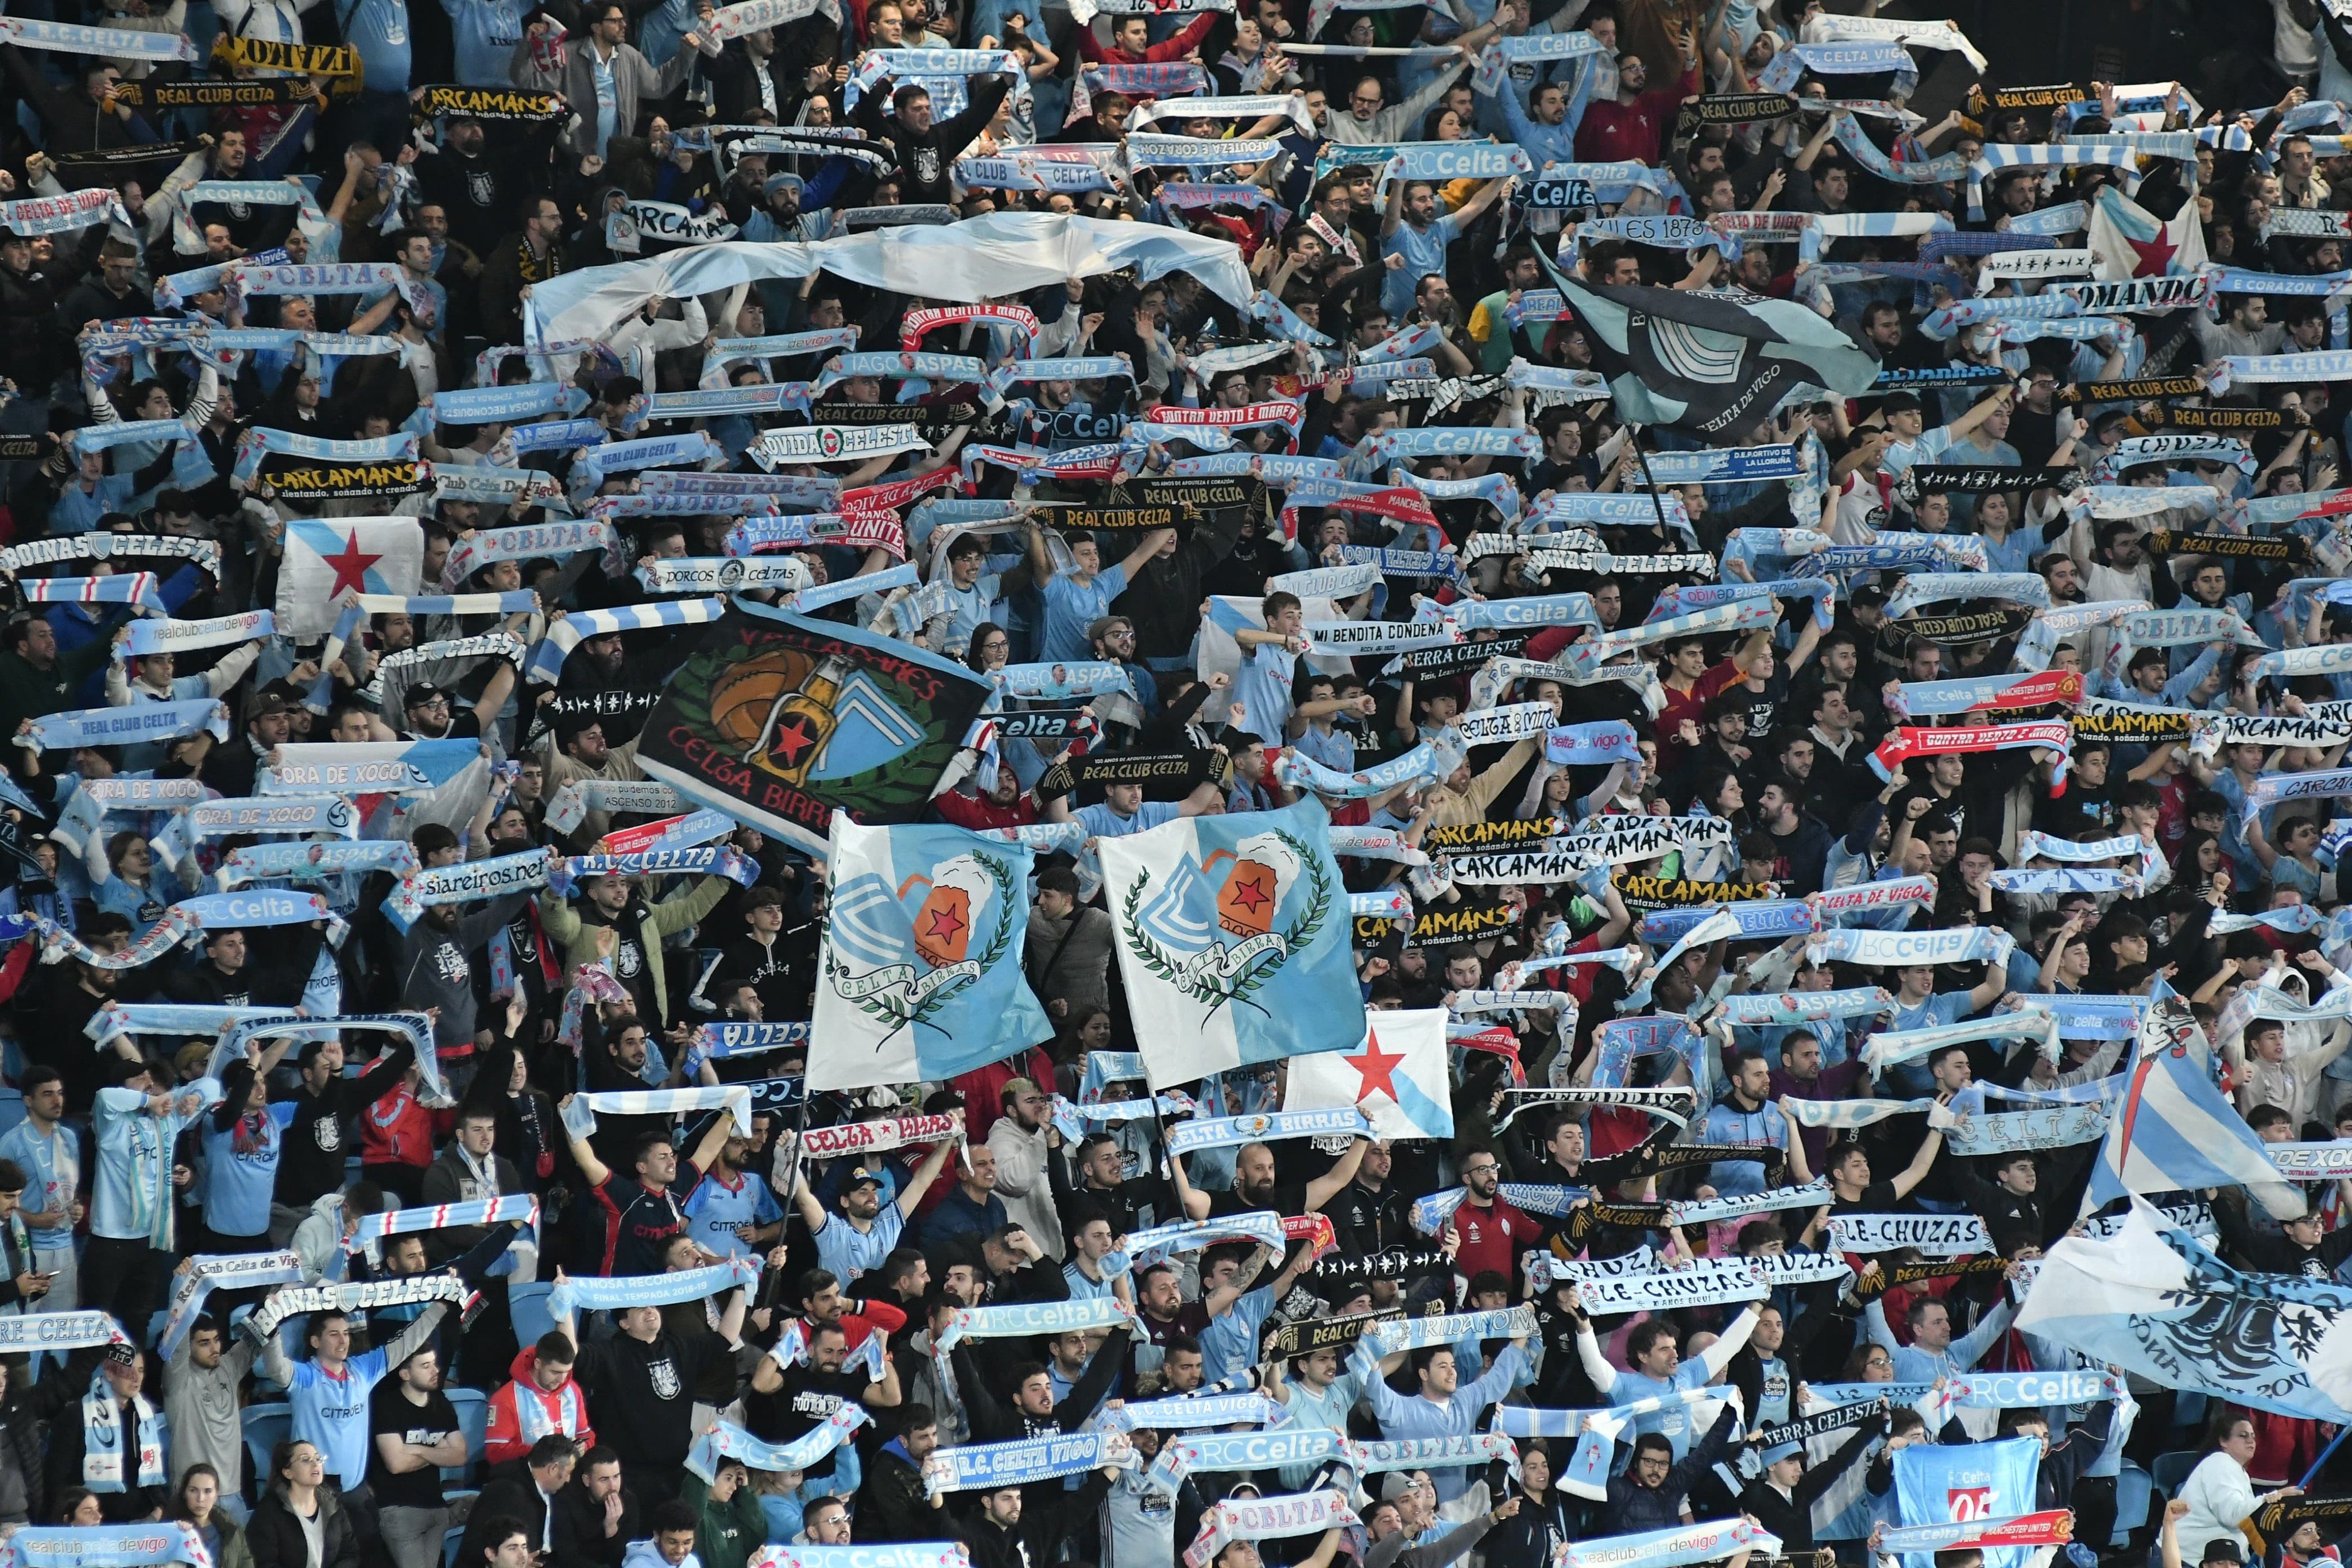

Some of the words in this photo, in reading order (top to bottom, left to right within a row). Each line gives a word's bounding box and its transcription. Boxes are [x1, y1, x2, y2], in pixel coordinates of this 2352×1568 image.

[1824, 49, 1869, 63] CELTA
[156, 88, 195, 103] REAL
[196, 89, 231, 103] CLUB
[235, 87, 275, 102] CELTA
[1995, 93, 2025, 107] REAL
[2027, 92, 2053, 106] CLUB
[2056, 88, 2085, 103] CELTA
[1700, 103, 1727, 118] REAL
[1729, 103, 1756, 117] CLUB
[1759, 99, 1790, 115] CELTA
[1211, 140, 1270, 152] AFOUTEZA
[977, 161, 1007, 181] CLUB
[1053, 167, 1092, 184] CELTA
[204, 184, 288, 202] CORAZÓN
[15, 201, 55, 220] CELTA
[57, 198, 76, 215] DE
[1664, 217, 1704, 238] 1873
[1754, 215, 1770, 230] DE
[276, 265, 374, 287] CELTA
[2246, 279, 2316, 293] CORAZÓN
[944, 306, 981, 317] VENTO
[1526, 294, 1565, 312] REAL
[853, 355, 899, 372] IAGO
[916, 356, 979, 373] ASPAS
[1355, 361, 1404, 380] CELTA
[514, 388, 540, 396] FINAL
[1740, 393, 1754, 411] DE
[1751, 364, 1781, 394] VIGO
[2091, 385, 2130, 400] REAL
[2132, 382, 2163, 397] CLUB
[442, 403, 513, 418] RECONQUISTA
[513, 401, 536, 411] NOSA
[814, 408, 848, 421] REAL
[850, 408, 887, 421] CLUB
[889, 407, 927, 420] CELTA
[1160, 409, 1205, 424] CONTRA
[1208, 406, 1245, 424] VENTO
[1259, 405, 1295, 420] MAREA
[2174, 409, 2207, 425] REAL
[2210, 411, 2242, 426] CLUB
[2244, 412, 2281, 426] CELTA
[2, 442, 38, 455] CELTA
[331, 438, 389, 455] CELTA
[601, 451, 626, 465] REAL
[627, 448, 650, 462] CLUB
[652, 442, 676, 459] CELTA
[1206, 458, 1249, 473] IAGO
[1263, 462, 1316, 478] ASPAS
[1649, 456, 1681, 472] Celta
[1689, 455, 1699, 469] B
[333, 486, 373, 497] soñando
[1210, 486, 1245, 502] CELTA
[1295, 481, 1336, 497] Celta
[1067, 509, 1098, 526] REAL
[1103, 509, 1136, 526] CLUB
[1138, 508, 1171, 525] CELTA
[501, 525, 582, 552] CELTA
[2181, 539, 2206, 555] REAL
[2212, 539, 2247, 556] CLUB
[2250, 541, 2288, 557] CELTA
[4, 537, 88, 571] BOINAS
[1612, 553, 1714, 576] CELESTE
[1948, 615, 1979, 632] CLUB
[1978, 611, 2007, 628] REAL
[2084, 610, 2102, 625] DE
[2133, 614, 2212, 640] CELTA
[1314, 629, 1328, 643] MI
[1333, 626, 1382, 640] BENDITA
[1388, 622, 1444, 640] CONDENA
[1457, 638, 1523, 663] CELESTE
[82, 719, 110, 735] REAL
[112, 716, 141, 733] CLUB
[144, 711, 177, 728] CELTA
[1460, 715, 1510, 739] CELTA
[1552, 734, 1575, 749] celta
[1576, 736, 1589, 748] de
[1592, 733, 1620, 750] vigo
[1976, 729, 2015, 743] VENTO
[2114, 733, 2149, 742] soñando
[327, 766, 349, 782] DE
[353, 762, 405, 781] XOGO
[1083, 765, 1116, 779] REAL
[1117, 762, 1150, 777] CLUB
[1152, 761, 1189, 776] CELTA
[1373, 752, 1430, 784] ASPAS
[131, 781, 152, 799] DE
[156, 780, 200, 798] XOGO
[605, 797, 652, 808] ASCENSO
[237, 807, 260, 824] DE
[265, 804, 316, 823] XOGO
[1022, 824, 1080, 842] ASPAS
[1475, 841, 1511, 851] soñando
[262, 850, 308, 867] IAGO
[318, 846, 384, 864] ASPAS
[649, 847, 717, 870] CELTA
[425, 857, 546, 896] siareiros.net
[1867, 891, 1885, 904] DE
[1890, 883, 1924, 901] VIGO
[1422, 934, 1464, 946] soñando
[115, 947, 136, 961] DE
[1179, 942, 1220, 992] CELTA
[1231, 934, 1283, 967] BIRRAS
[842, 965, 908, 996] CELTA
[922, 960, 976, 995] BIRRAS
[1472, 989, 1553, 1005] CELTA
[1737, 994, 1782, 1014] IAGO
[1798, 991, 1866, 1011] ASPAS
[1101, 1053, 1124, 1075] RC
[1281, 1112, 1356, 1130] BIRRAS
[2284, 1147, 2307, 1166] DE
[1846, 1218, 1979, 1244] LE-CHUZAS
[176, 1269, 201, 1304] Real
[226, 1259, 258, 1272] Celta
[260, 1256, 274, 1269] de
[579, 1279, 587, 1288] A
[590, 1276, 625, 1290] NOSA
[628, 1264, 721, 1288] RECONQUISTA
[1599, 1271, 1756, 1302] LE-CHUZAS
[593, 1292, 629, 1304] FINAL
[632, 1288, 672, 1301] TEMPADA
[674, 1281, 707, 1297] 2018-19
[37, 1317, 110, 1342] CELTA
[1312, 1326, 1341, 1345] REAL
[1162, 1400, 1211, 1416] CELTA
[1217, 1396, 1261, 1412] VIGO
[1763, 1419, 1813, 1446] TERRA
[1817, 1400, 1881, 1435] CELESTE
[995, 1446, 1047, 1472] CELTA
[1051, 1439, 1094, 1459] VIGO
[1372, 1436, 1476, 1463] CELTA
[1241, 1499, 1326, 1529] CELTA
[1985, 1524, 2026, 1536] MANCHESTER
[2027, 1521, 2051, 1533] UNITED
